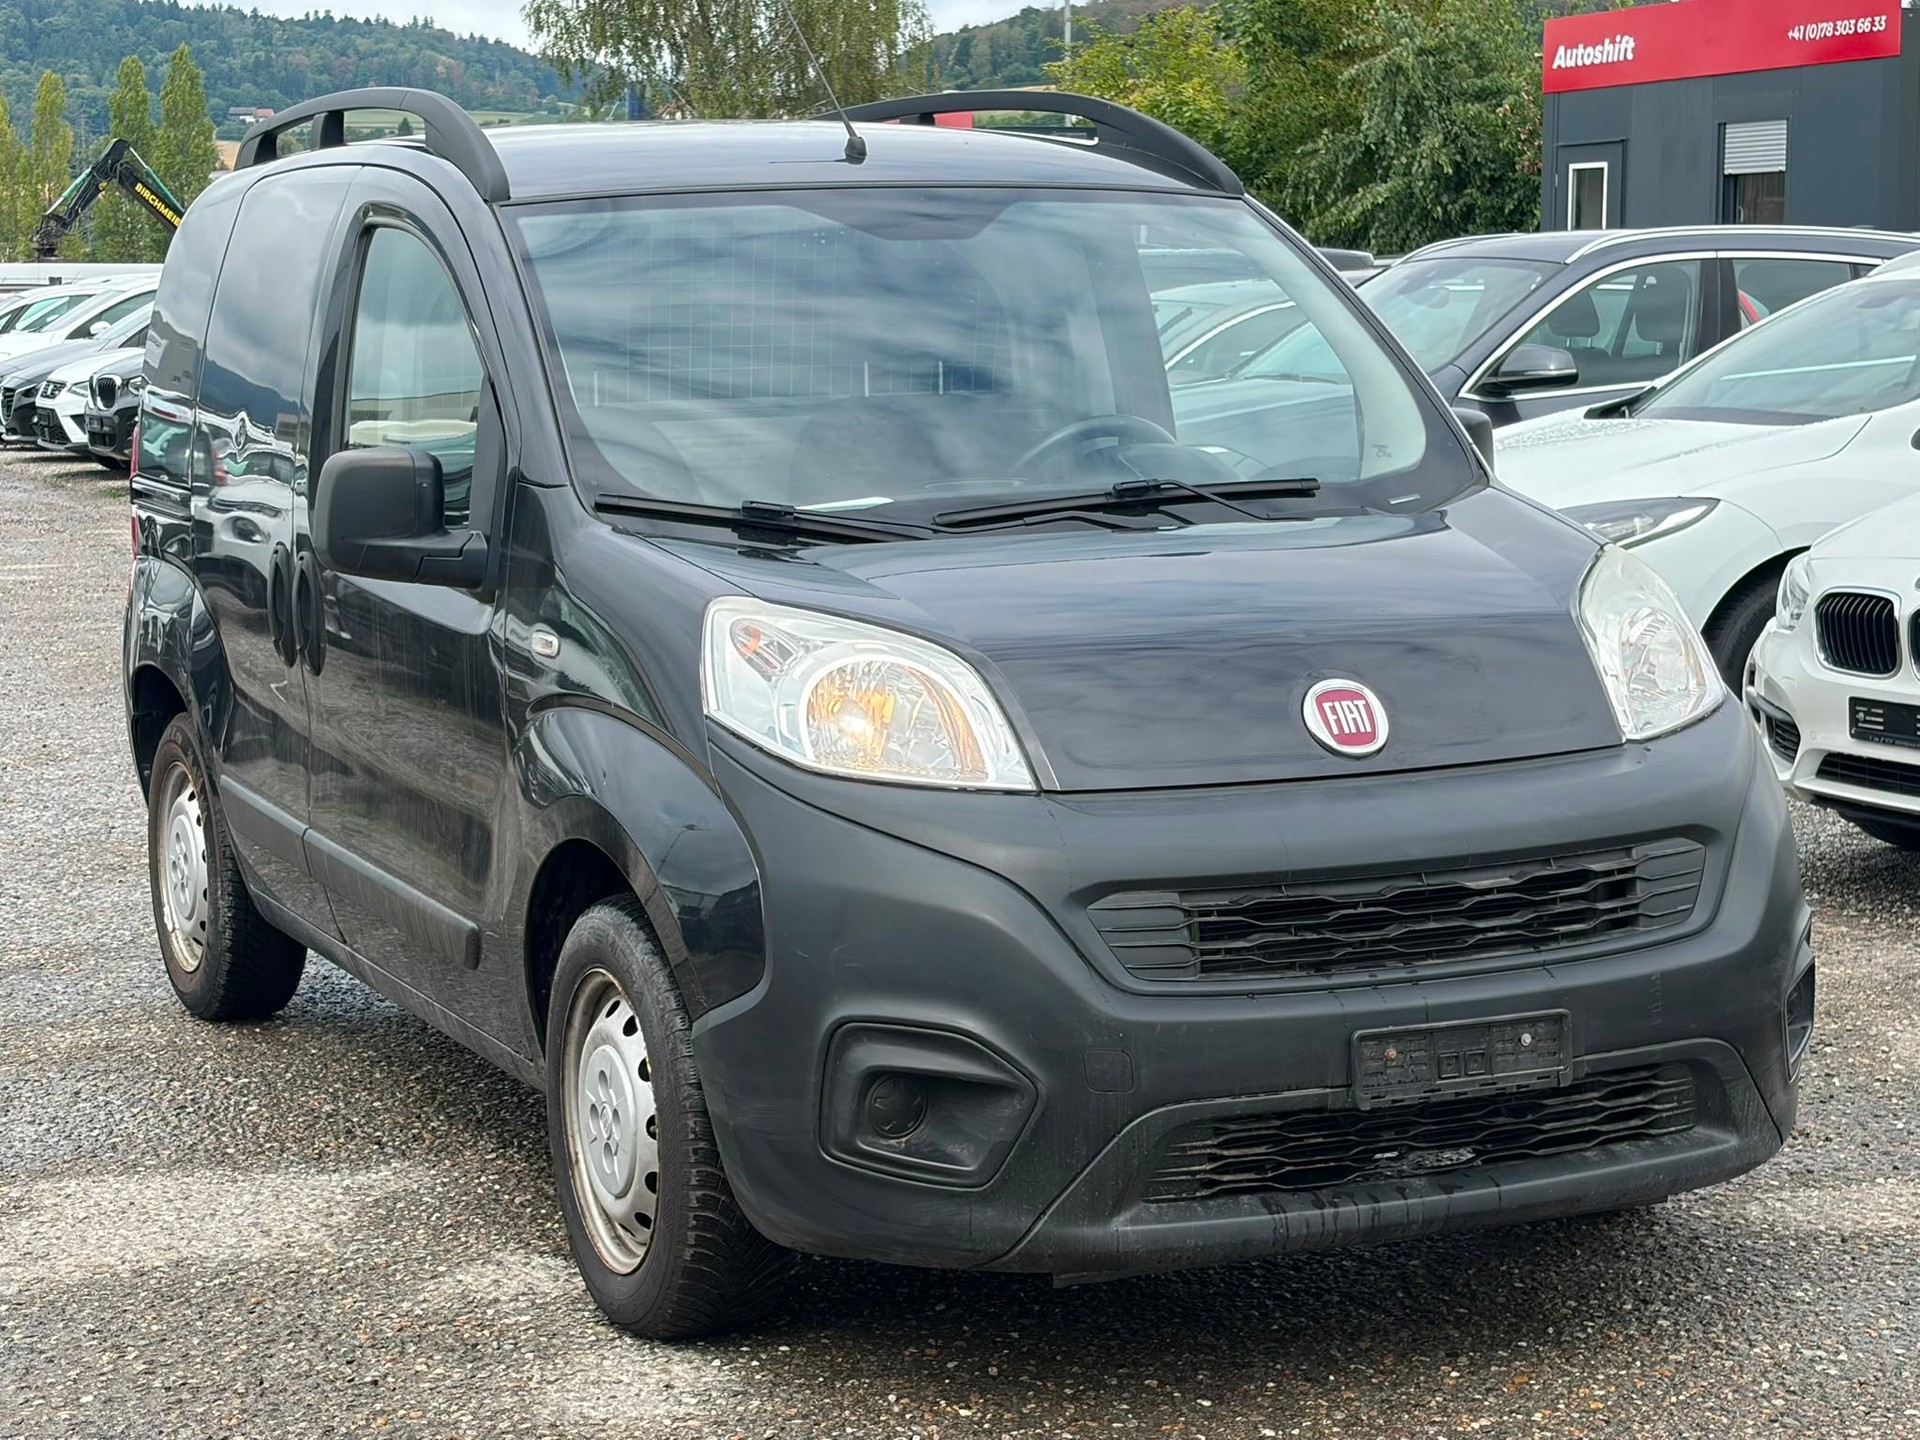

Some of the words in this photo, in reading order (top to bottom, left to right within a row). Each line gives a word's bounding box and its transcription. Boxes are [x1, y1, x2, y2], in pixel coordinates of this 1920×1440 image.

[1788, 26, 1804, 40] +41
[1805, 22, 1833, 41] (0)78
[1834, 19, 1856, 36] 303
[1857, 17, 1872, 33] 66
[1872, 15, 1887, 31] 33
[1552, 34, 1635, 69] Autoshift
[1322, 700, 1372, 735] FIAT
